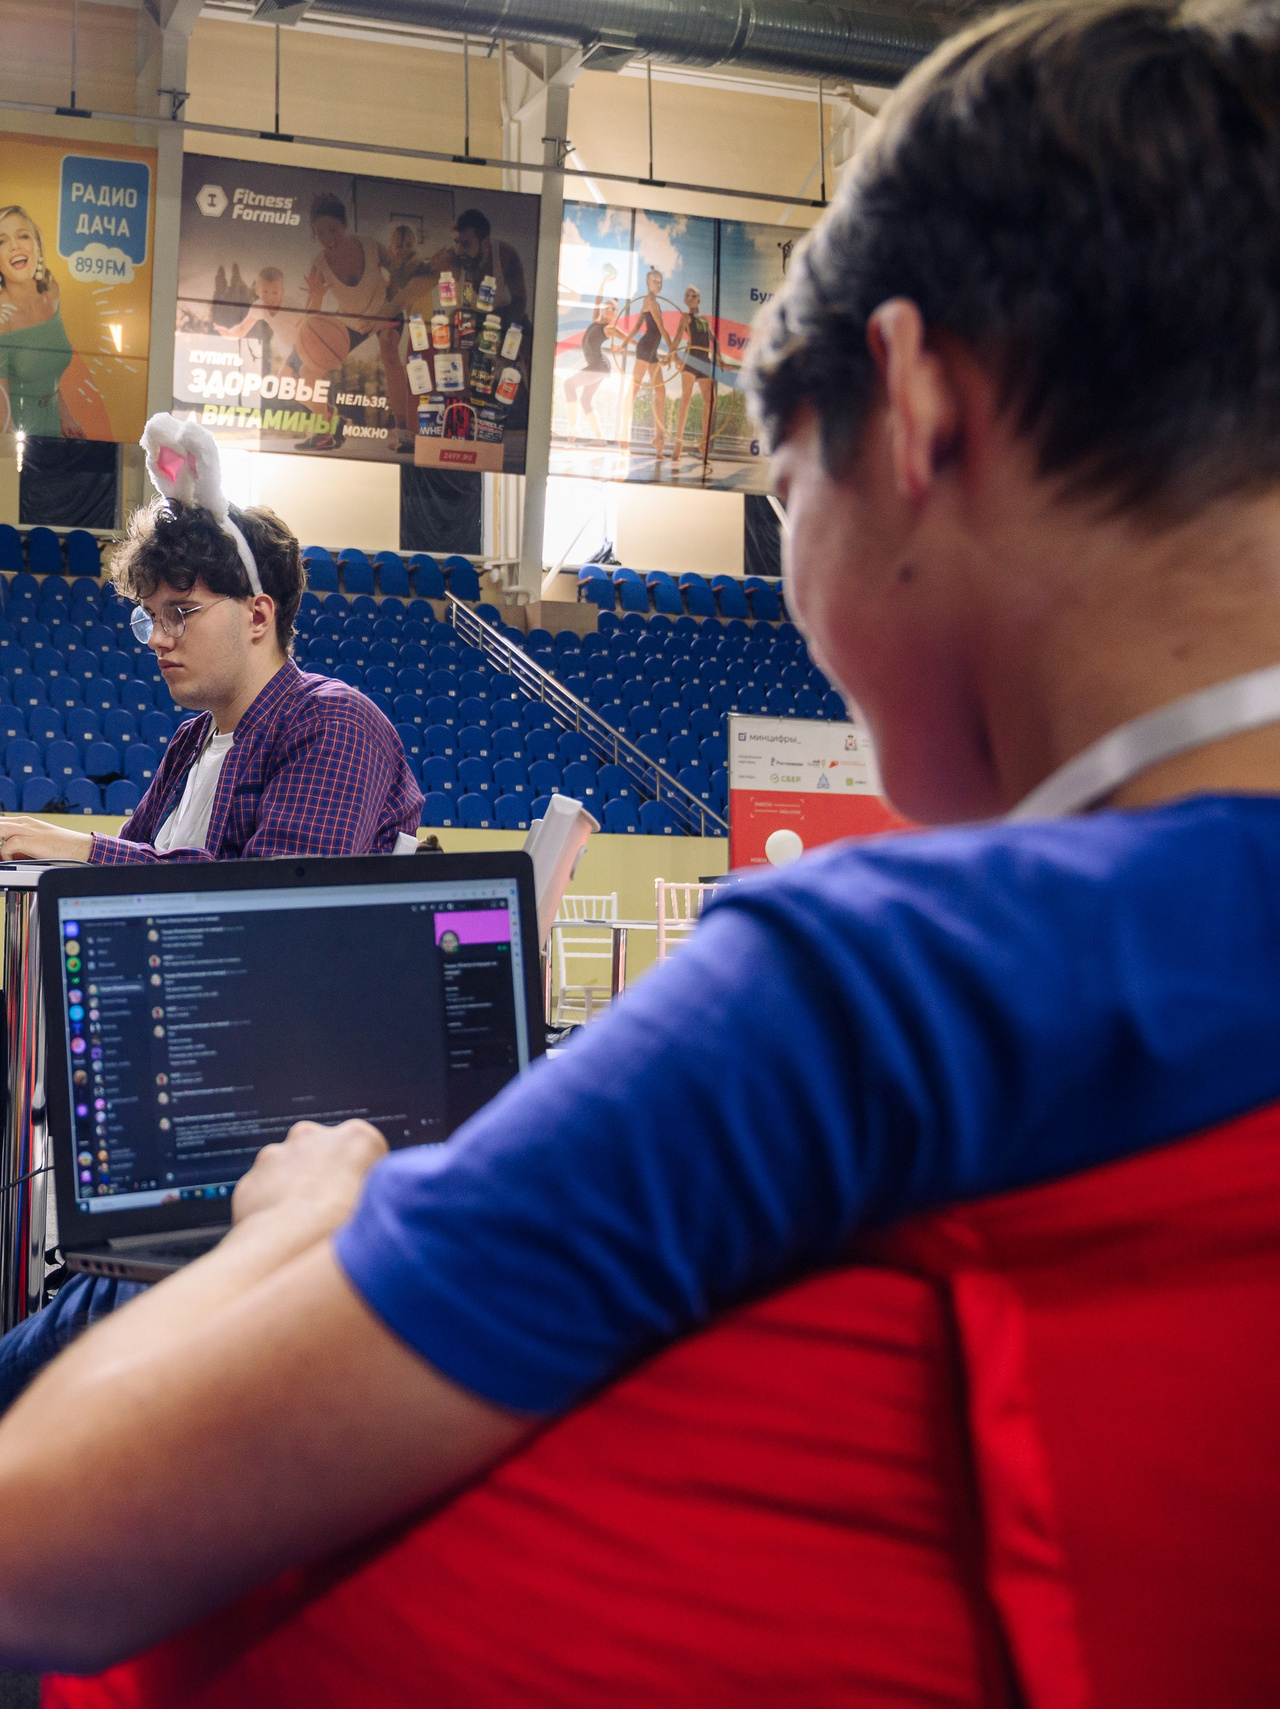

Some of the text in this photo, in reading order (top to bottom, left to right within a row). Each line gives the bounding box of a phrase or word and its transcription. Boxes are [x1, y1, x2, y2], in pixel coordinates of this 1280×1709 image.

[71, 182, 138, 209] РАДИО
[232, 188, 293, 210] Fitness
[75, 213, 131, 238] ДАЧА
[231, 204, 301, 226] Formula
[189, 350, 243, 367] КУПИТЬ
[187, 368, 390, 411] ЗДОРОВЬЕ НЕЛЬЗЯ,
[201, 404, 339, 435] ВИТАМИНЫ
[342, 425, 389, 440] МОЖНО
